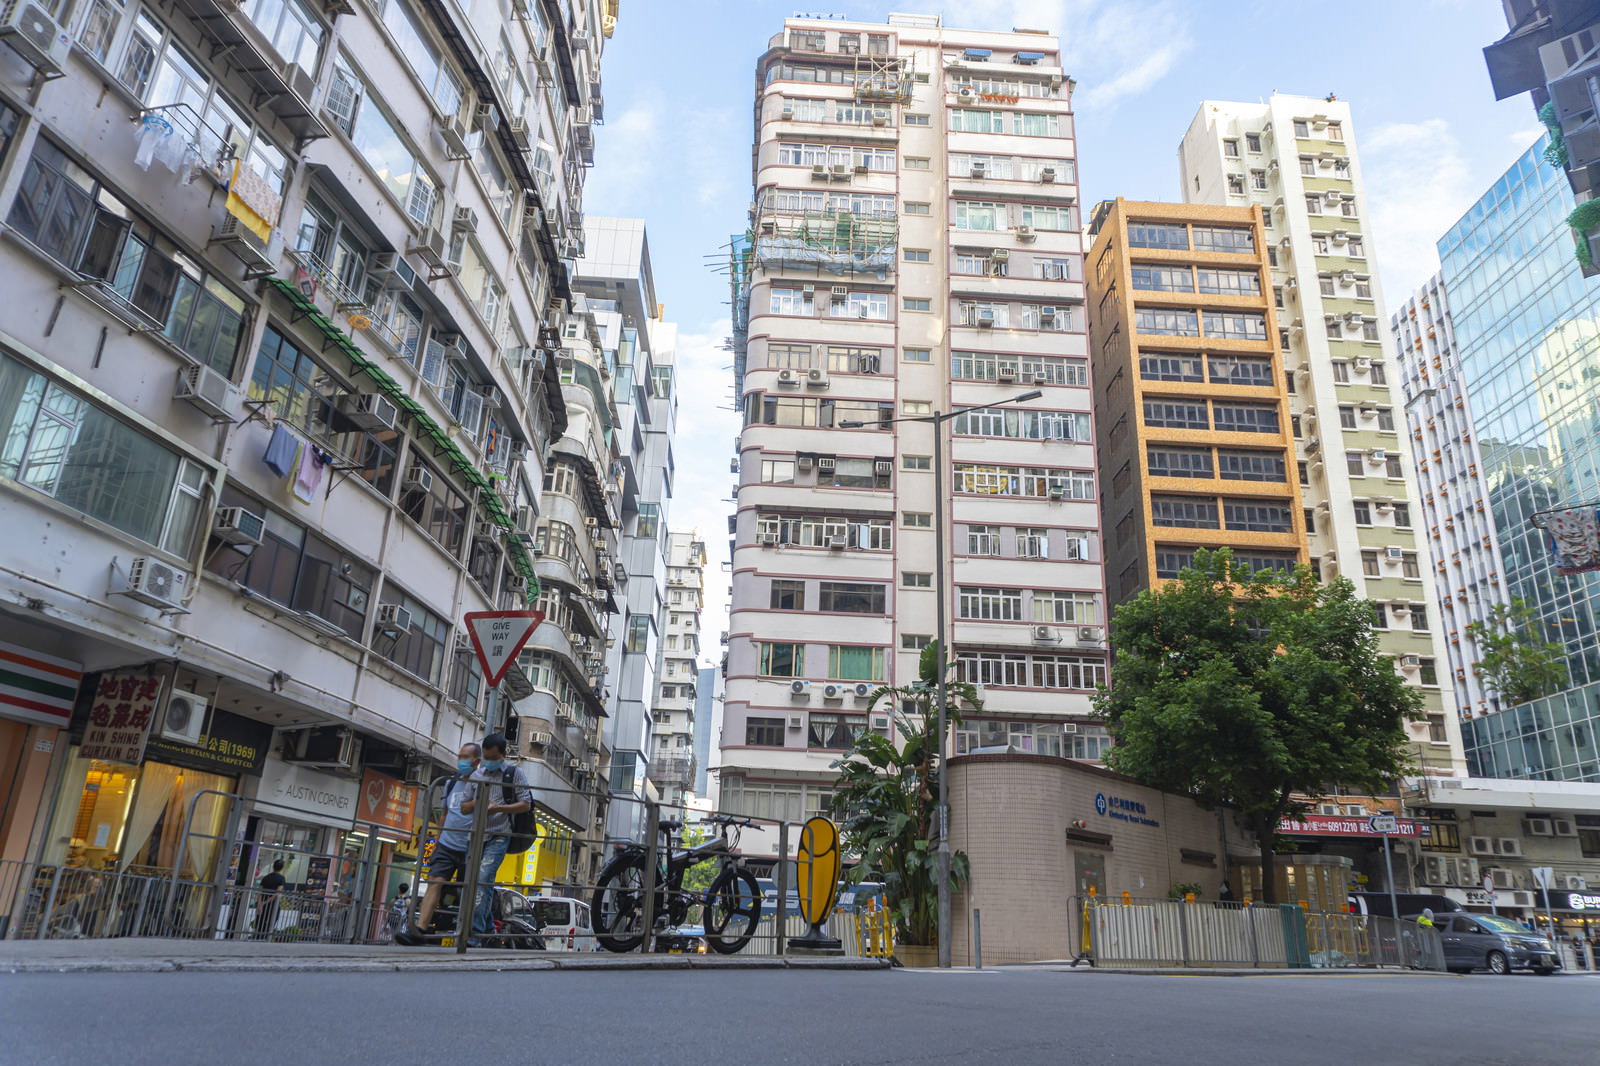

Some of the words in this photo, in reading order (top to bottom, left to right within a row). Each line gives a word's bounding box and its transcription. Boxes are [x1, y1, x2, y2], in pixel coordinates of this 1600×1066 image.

[492, 622, 511, 630] GIVE
[491, 632, 509, 641] WAY
[89, 730, 107, 743] KIN
[110, 731, 140, 745] SHING
[80, 744, 123, 759] CURTAIN
[126, 747, 140, 761] CO
[285, 784, 318, 802] AUSTIN
[317, 791, 349, 809] CORNER
